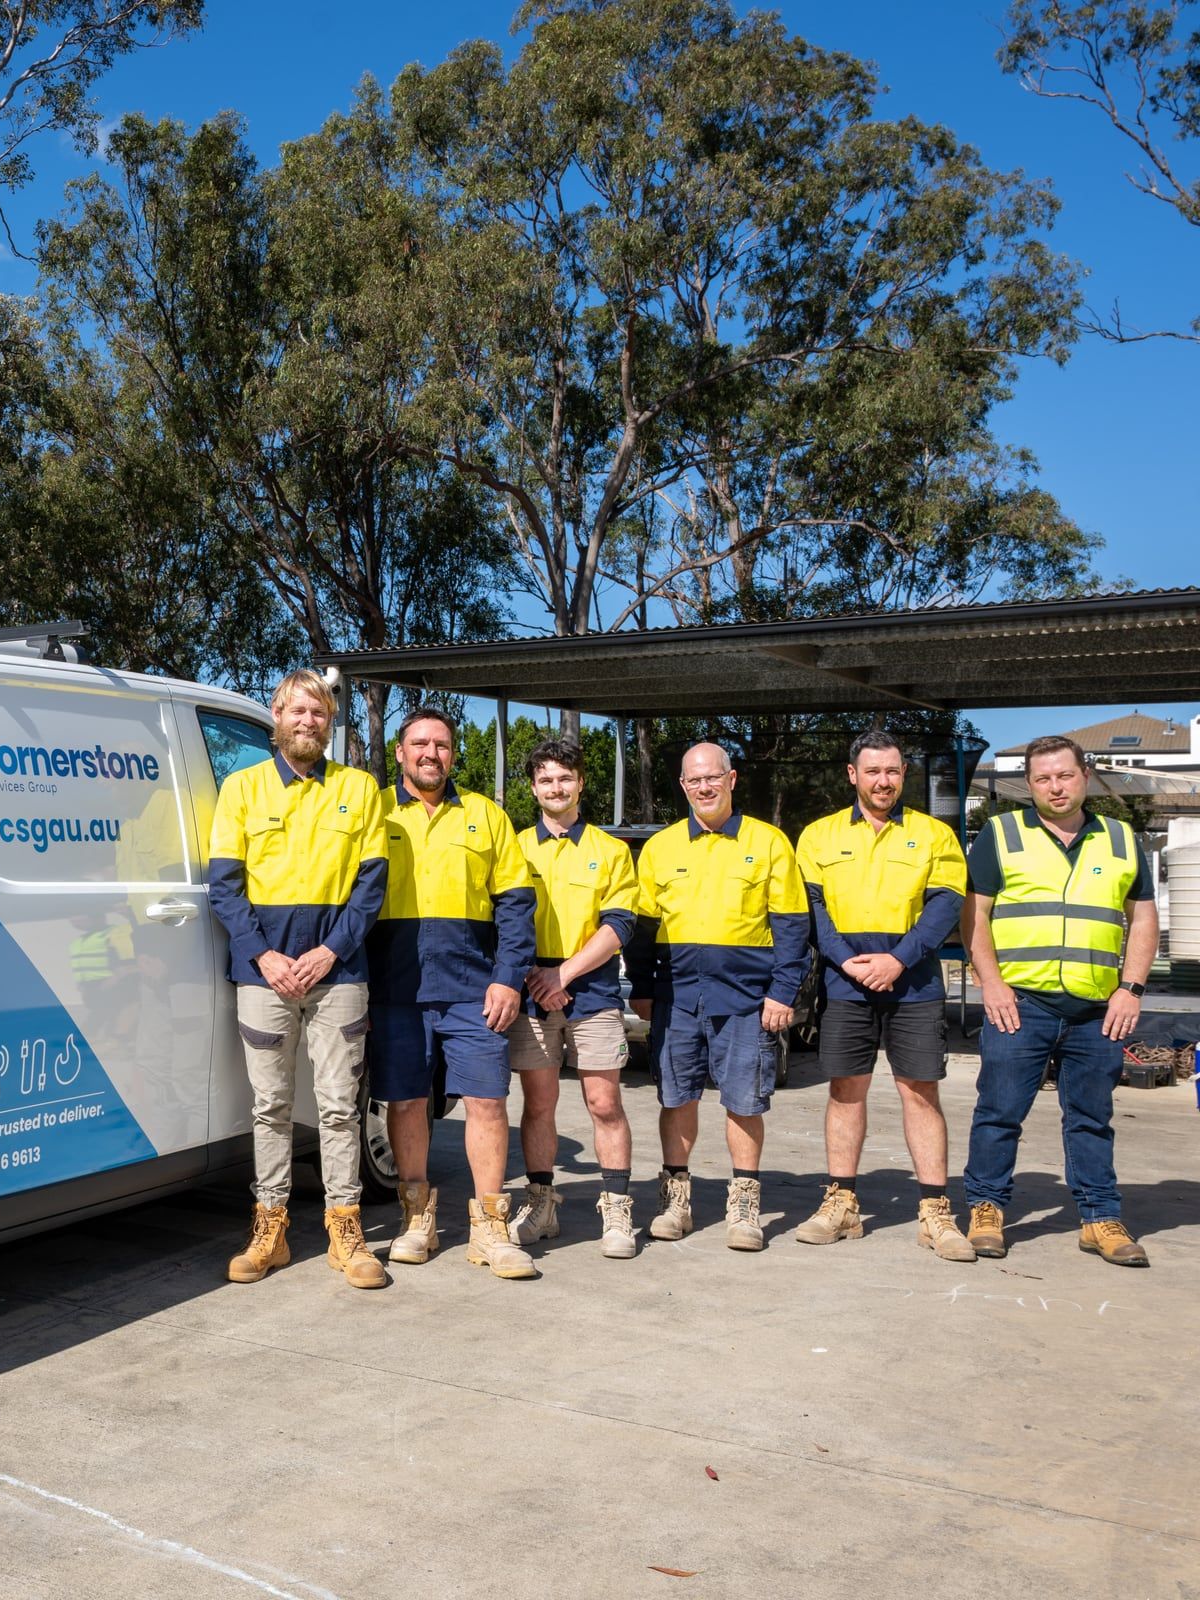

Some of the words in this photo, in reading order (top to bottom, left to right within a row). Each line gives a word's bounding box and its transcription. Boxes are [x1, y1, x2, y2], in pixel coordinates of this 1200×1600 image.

[28, 781, 58, 796] Group
[0, 817, 121, 853] csgau.au
[43, 1112, 57, 1127] to
[58, 1104, 105, 1124] deliver.
[12, 1146, 41, 1168] 9613
